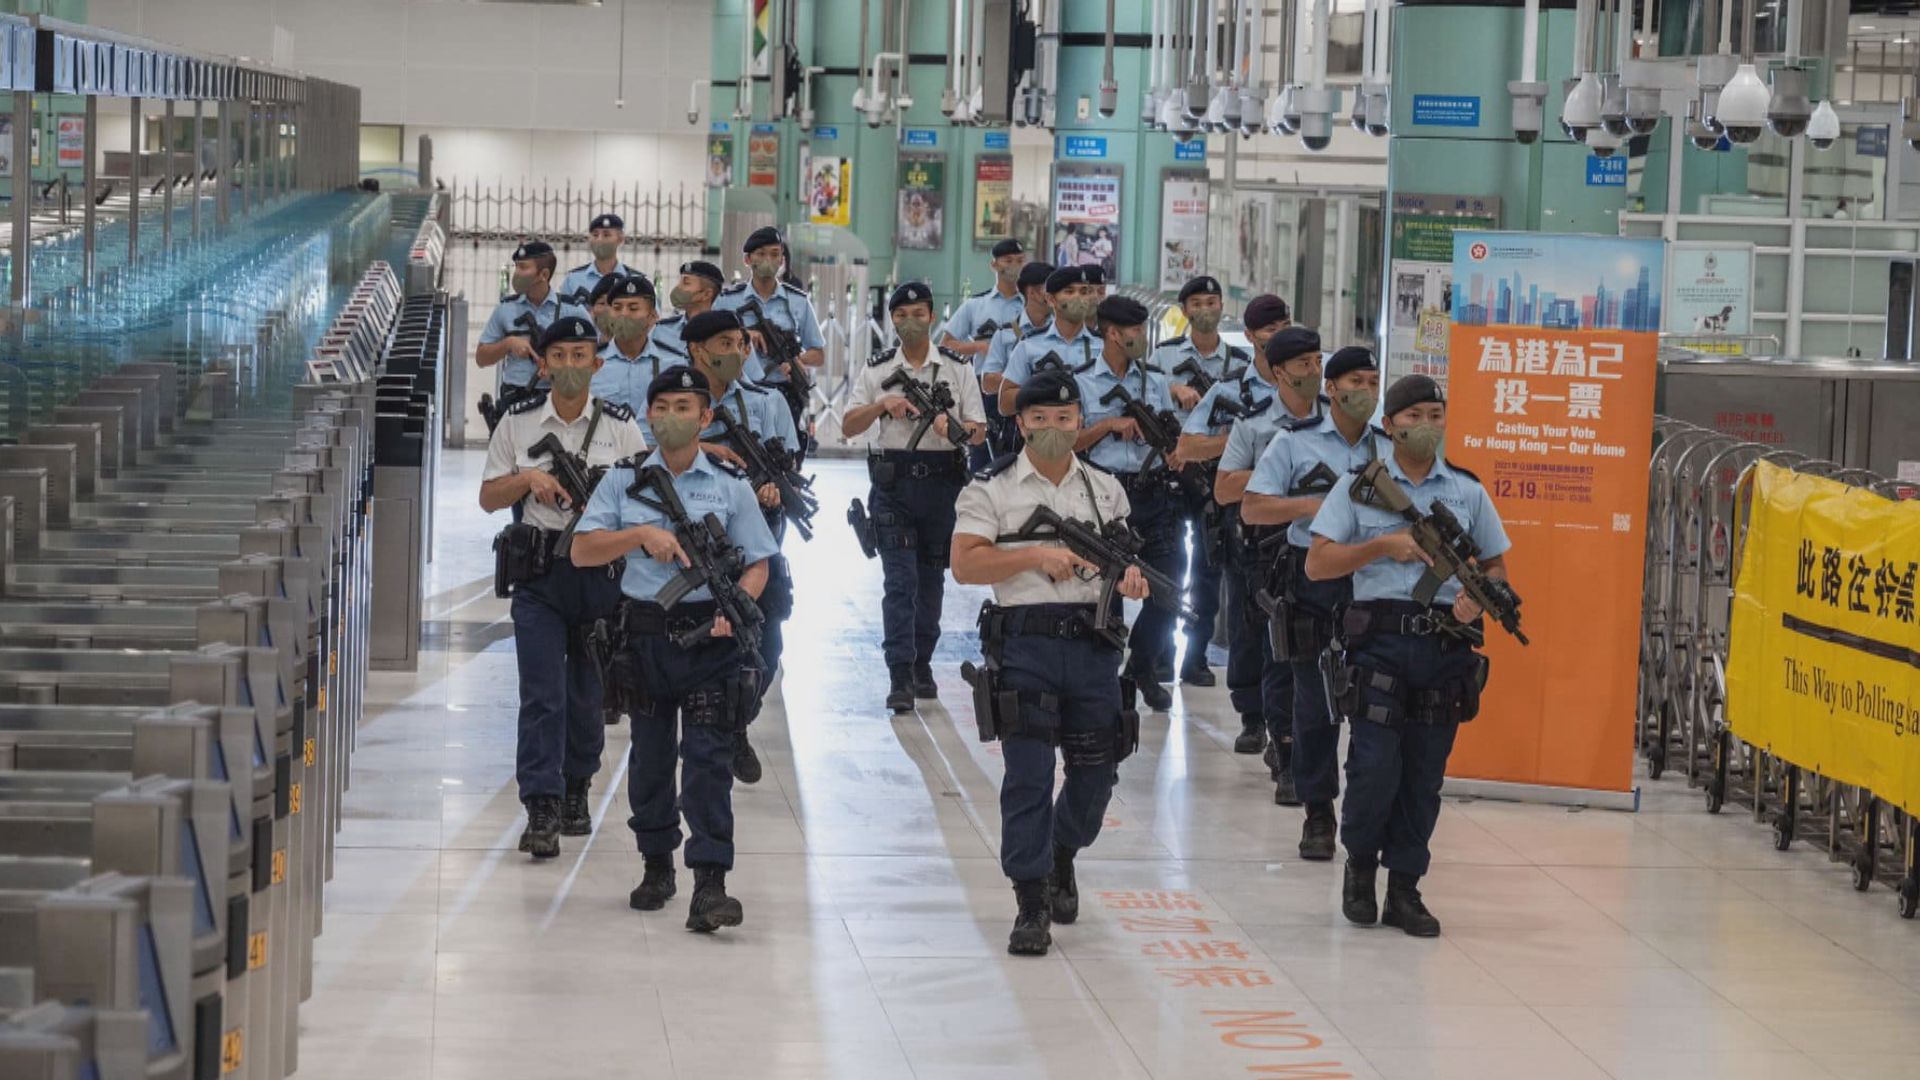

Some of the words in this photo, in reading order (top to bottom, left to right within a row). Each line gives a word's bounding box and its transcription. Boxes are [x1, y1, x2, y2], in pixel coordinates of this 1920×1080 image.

[1477, 336, 1624, 380] 為港為己
[1493, 378, 1604, 419] 投一票
[1464, 435, 1483, 448] For
[1486, 436, 1516, 453] Hong
[1519, 438, 1548, 455] Kong
[1569, 442, 1590, 454] Our
[1593, 443, 1626, 457] Home
[1496, 422, 1539, 438] Casting
[1542, 424, 1568, 437] Your
[1570, 426, 1596, 439] Vote
[1784, 656, 1809, 696] This
[1813, 666, 1839, 715] Way
[1841, 680, 1853, 711] to
[1856, 680, 1905, 737] Polling
[249, 933, 266, 965] 41
[223, 1031, 242, 1068] 42
[1200, 1009, 1324, 1051] NO
